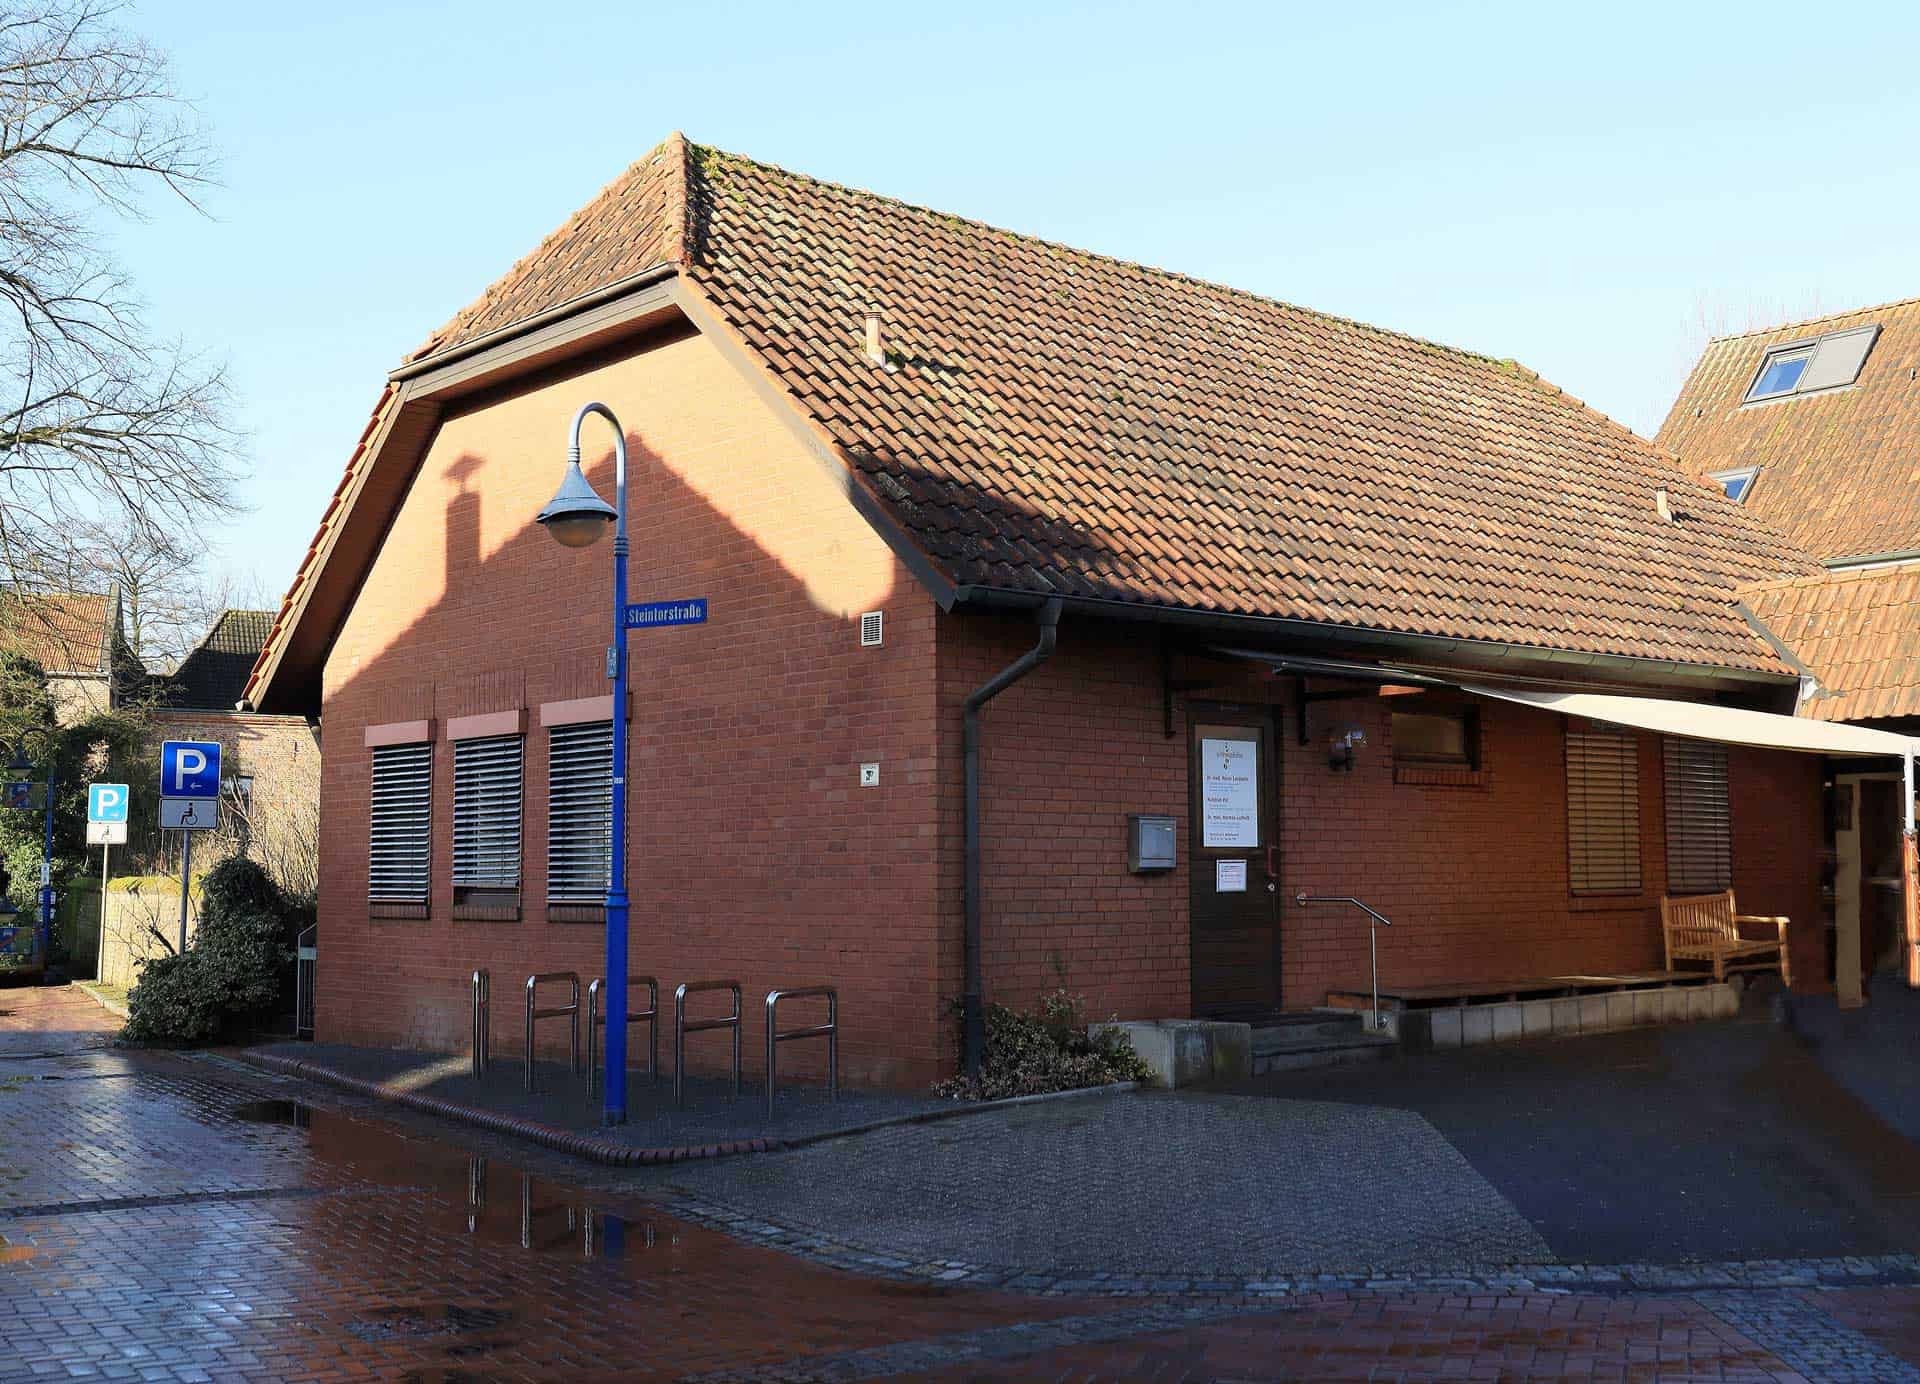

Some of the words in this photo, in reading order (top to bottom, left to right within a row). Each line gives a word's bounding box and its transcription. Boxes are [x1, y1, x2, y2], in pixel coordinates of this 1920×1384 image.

[628, 604, 701, 624] Steintorstraße
[175, 749, 207, 790] P
[97, 789, 119, 817] P
